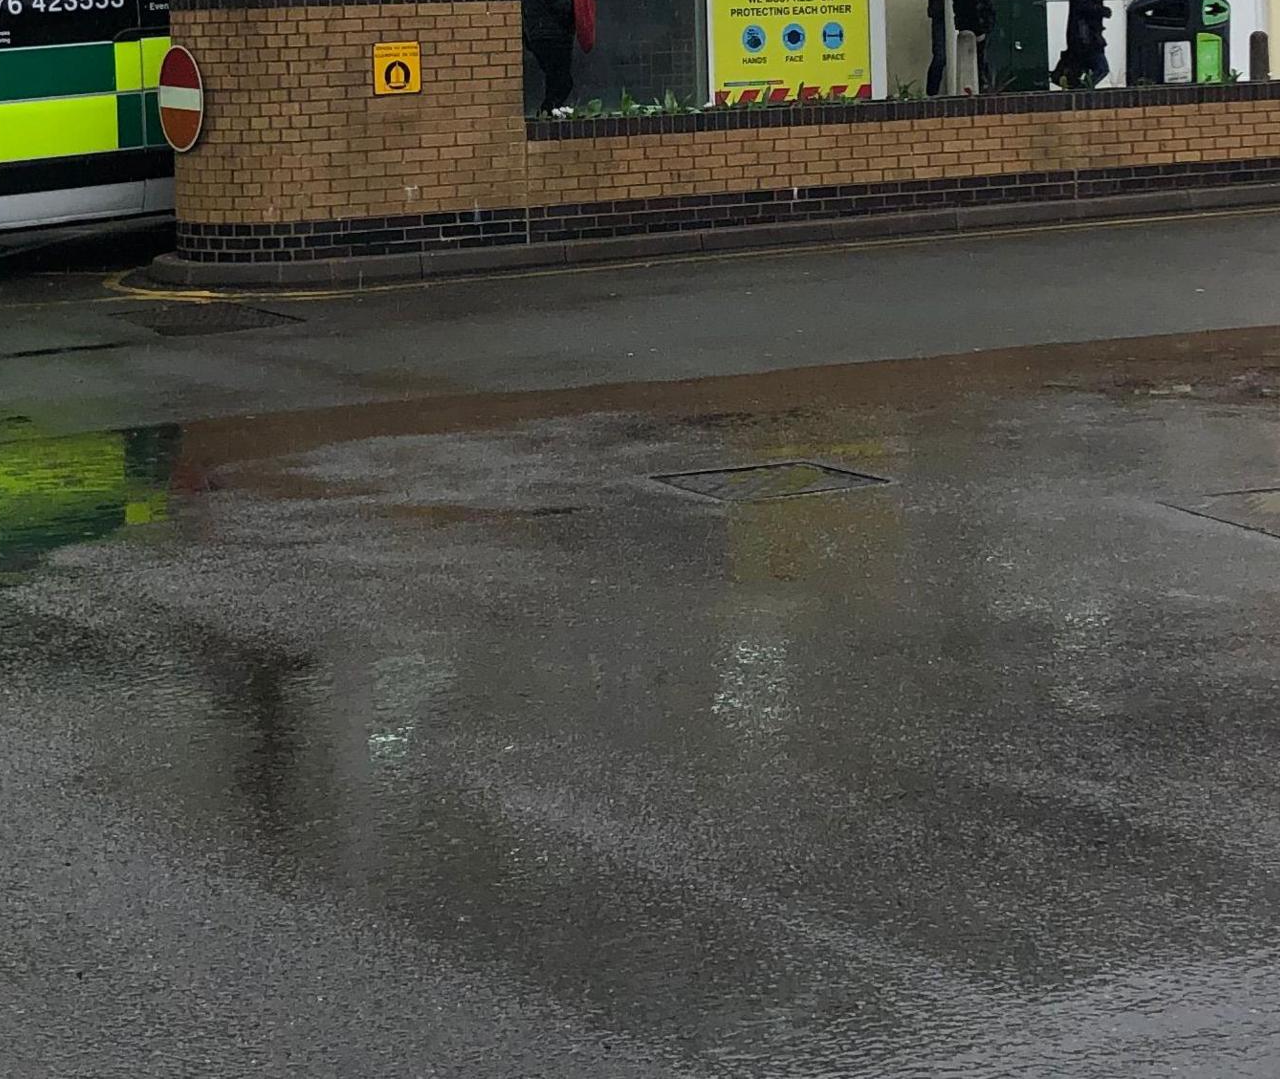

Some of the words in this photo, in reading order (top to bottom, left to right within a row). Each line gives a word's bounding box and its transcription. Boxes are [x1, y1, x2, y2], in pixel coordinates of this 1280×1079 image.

[148, 2, 169, 11] Even
[730, 7, 790, 18] PROTECTING
[792, 5, 818, 15] EACH
[820, 4, 852, 15] OTHER
[742, 56, 768, 65] HANDS
[785, 55, 805, 63] FACE
[822, 53, 846, 62] SPACE
